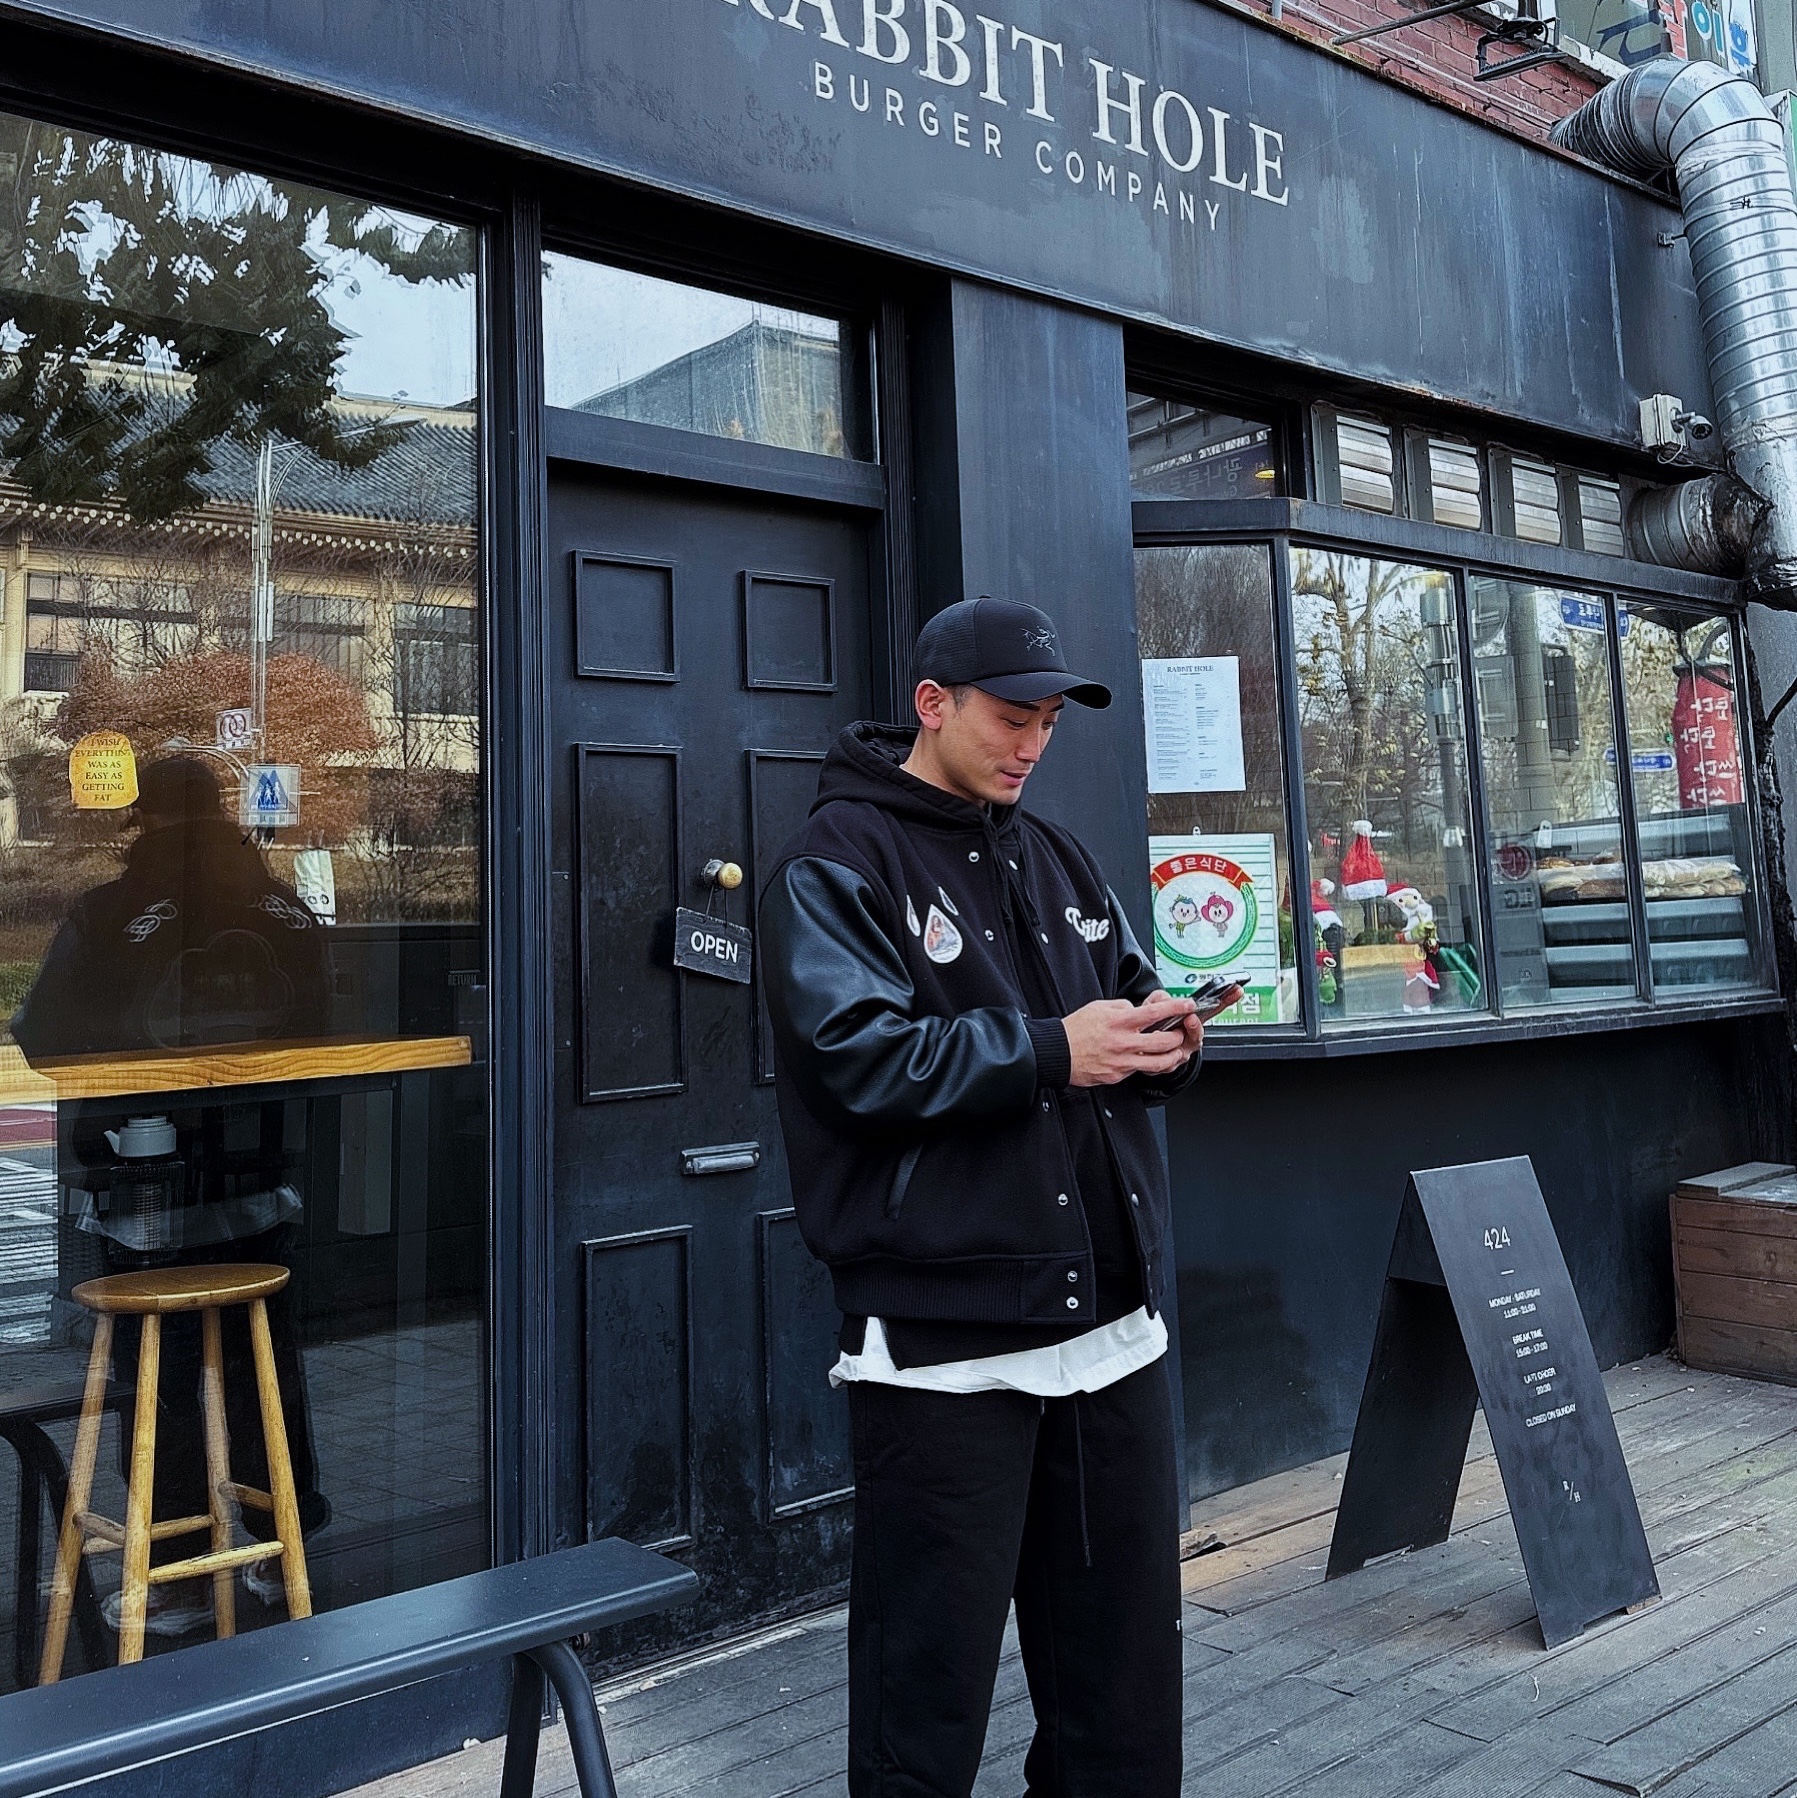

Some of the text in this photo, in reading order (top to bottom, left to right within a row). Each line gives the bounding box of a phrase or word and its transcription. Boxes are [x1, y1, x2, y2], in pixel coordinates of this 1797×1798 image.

[1088, 57, 1289, 206] HOLE
[814, 61, 1220, 231] BURGER COMPANY
[98, 738, 120, 746] WISH
[1170, 857, 1227, 874] 좋은식단
[691, 930, 738, 964] OPEN
[1484, 1226, 1511, 1250] 424
[1489, 1295, 1512, 1308] MONDAY
[1525, 1413, 1547, 1427] CLOSED
[1555, 1403, 1576, 1418] SUNDAY
